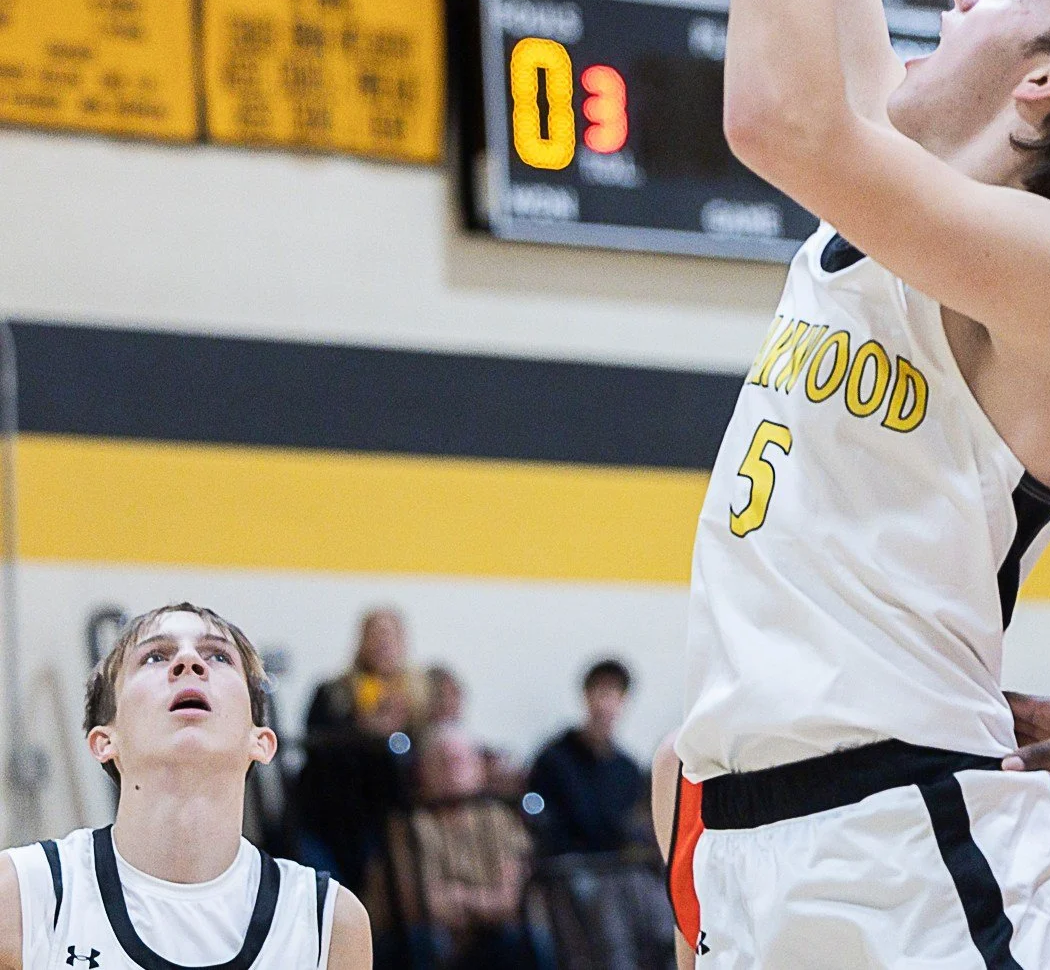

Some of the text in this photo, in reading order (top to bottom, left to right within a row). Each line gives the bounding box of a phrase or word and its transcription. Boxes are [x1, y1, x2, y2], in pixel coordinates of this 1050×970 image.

[510, 36, 576, 170] 0
[580, 64, 628, 154] 3
[729, 418, 793, 539] 5
